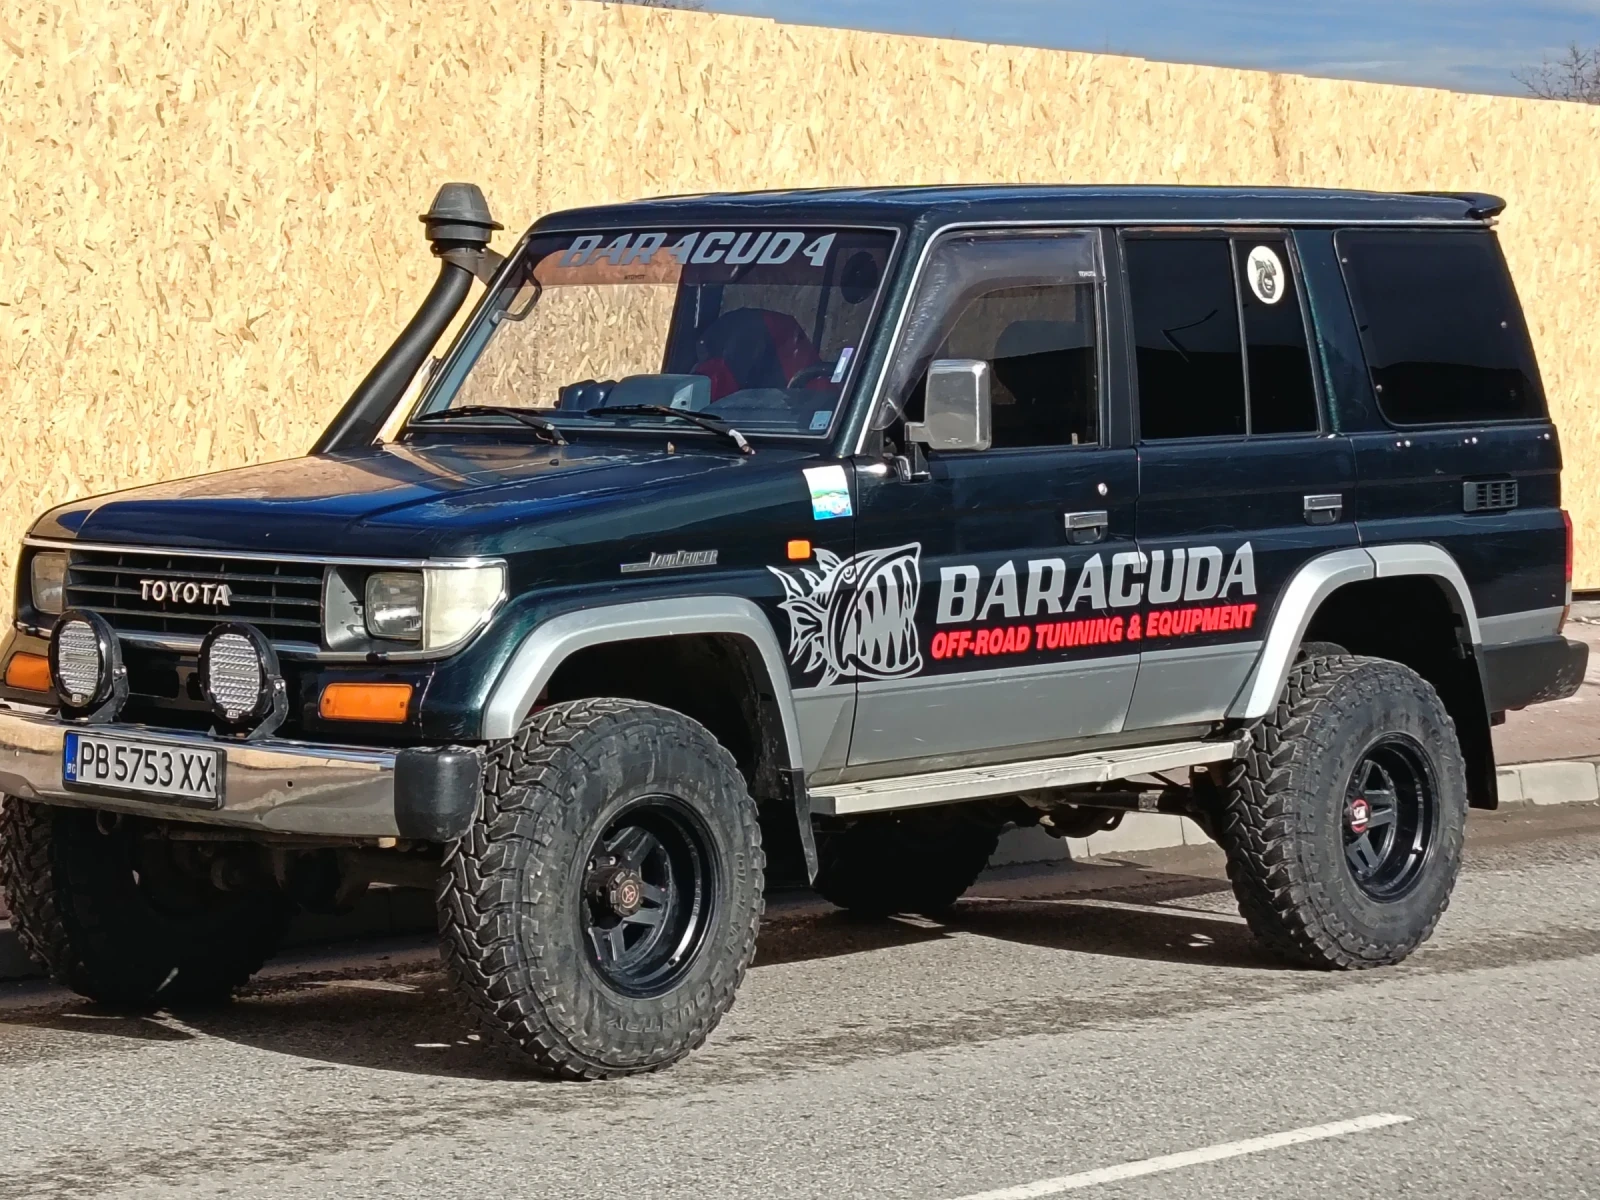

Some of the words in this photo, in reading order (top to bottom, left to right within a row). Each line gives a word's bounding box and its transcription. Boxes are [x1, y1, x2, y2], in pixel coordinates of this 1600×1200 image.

[557, 231, 837, 267] BARACUDA
[140, 580, 232, 606] TOYOTA
[936, 541, 1257, 625] BARACUDA
[931, 625, 1031, 660] OFF-ROAD
[1036, 616, 1123, 649] TUNNING
[1127, 616, 1141, 641] &
[1146, 604, 1257, 638] EQUIPMENT
[80, 742, 110, 778] PB
[114, 746, 173, 787] 5753
[180, 753, 211, 792] XX
